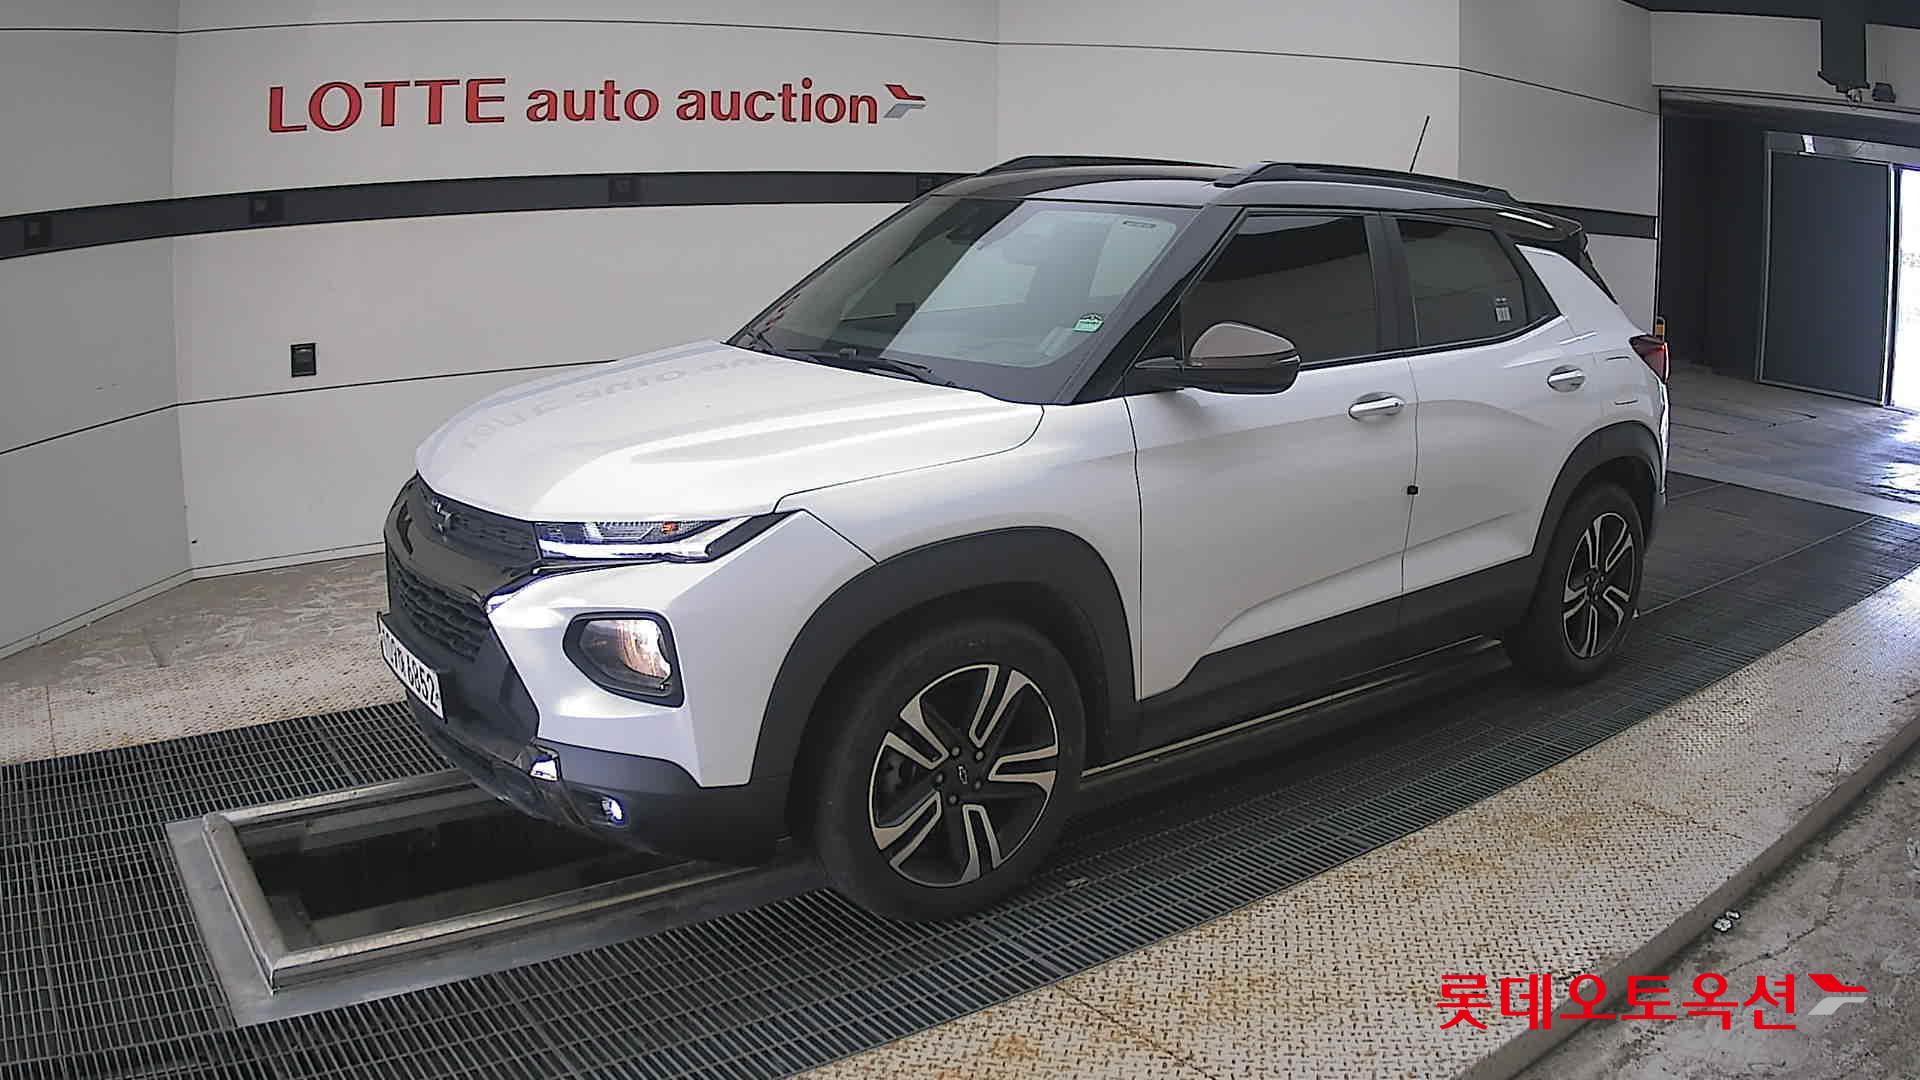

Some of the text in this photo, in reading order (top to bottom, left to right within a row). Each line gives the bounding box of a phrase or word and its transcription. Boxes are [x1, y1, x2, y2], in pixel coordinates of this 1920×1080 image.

[268, 77, 879, 133] LOTTE auto auction
